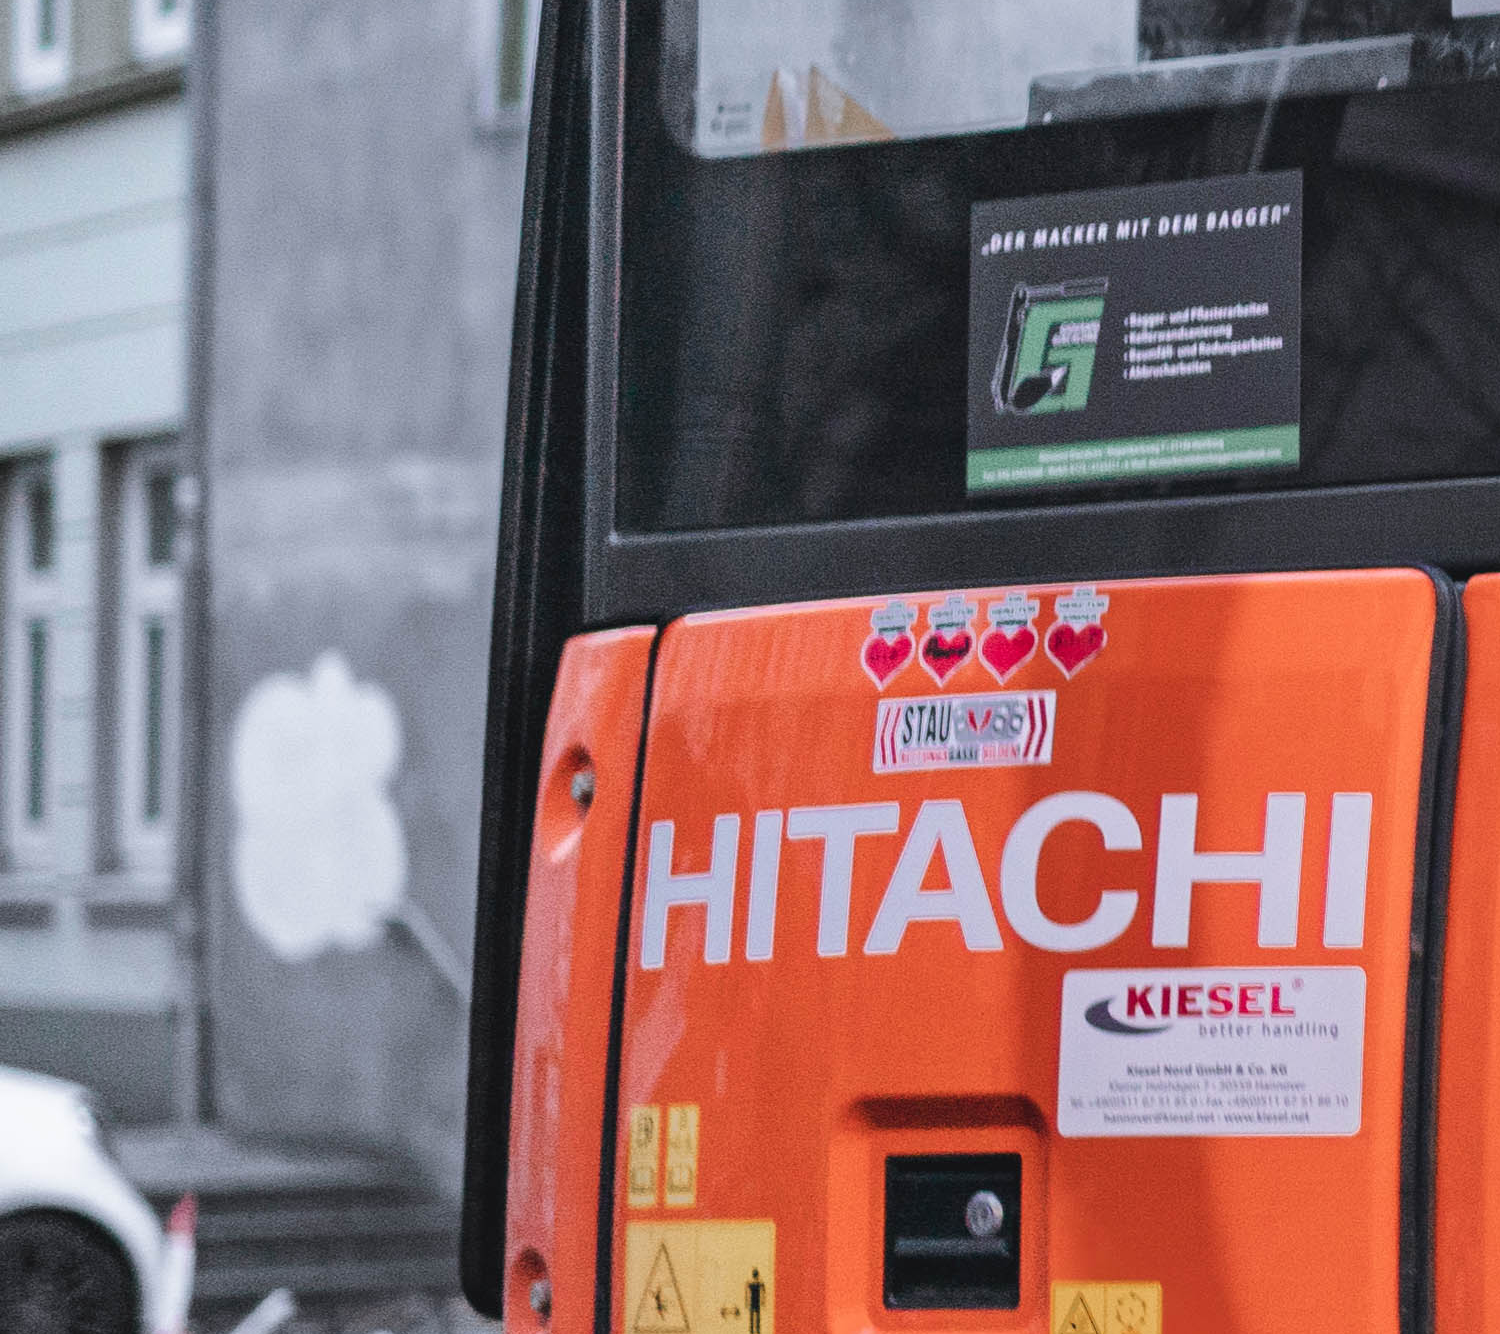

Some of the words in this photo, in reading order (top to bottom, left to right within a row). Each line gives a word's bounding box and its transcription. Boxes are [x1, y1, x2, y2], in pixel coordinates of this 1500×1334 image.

[1032, 222, 1108, 248] MACKER
[1116, 217, 1151, 240] MIT
[1157, 213, 1198, 237] DEM
[902, 703, 952, 745] STAU
[641, 790, 1374, 970] HITACHI
[1199, 1022, 1251, 1038] better
[1262, 1021, 1339, 1038] handling
